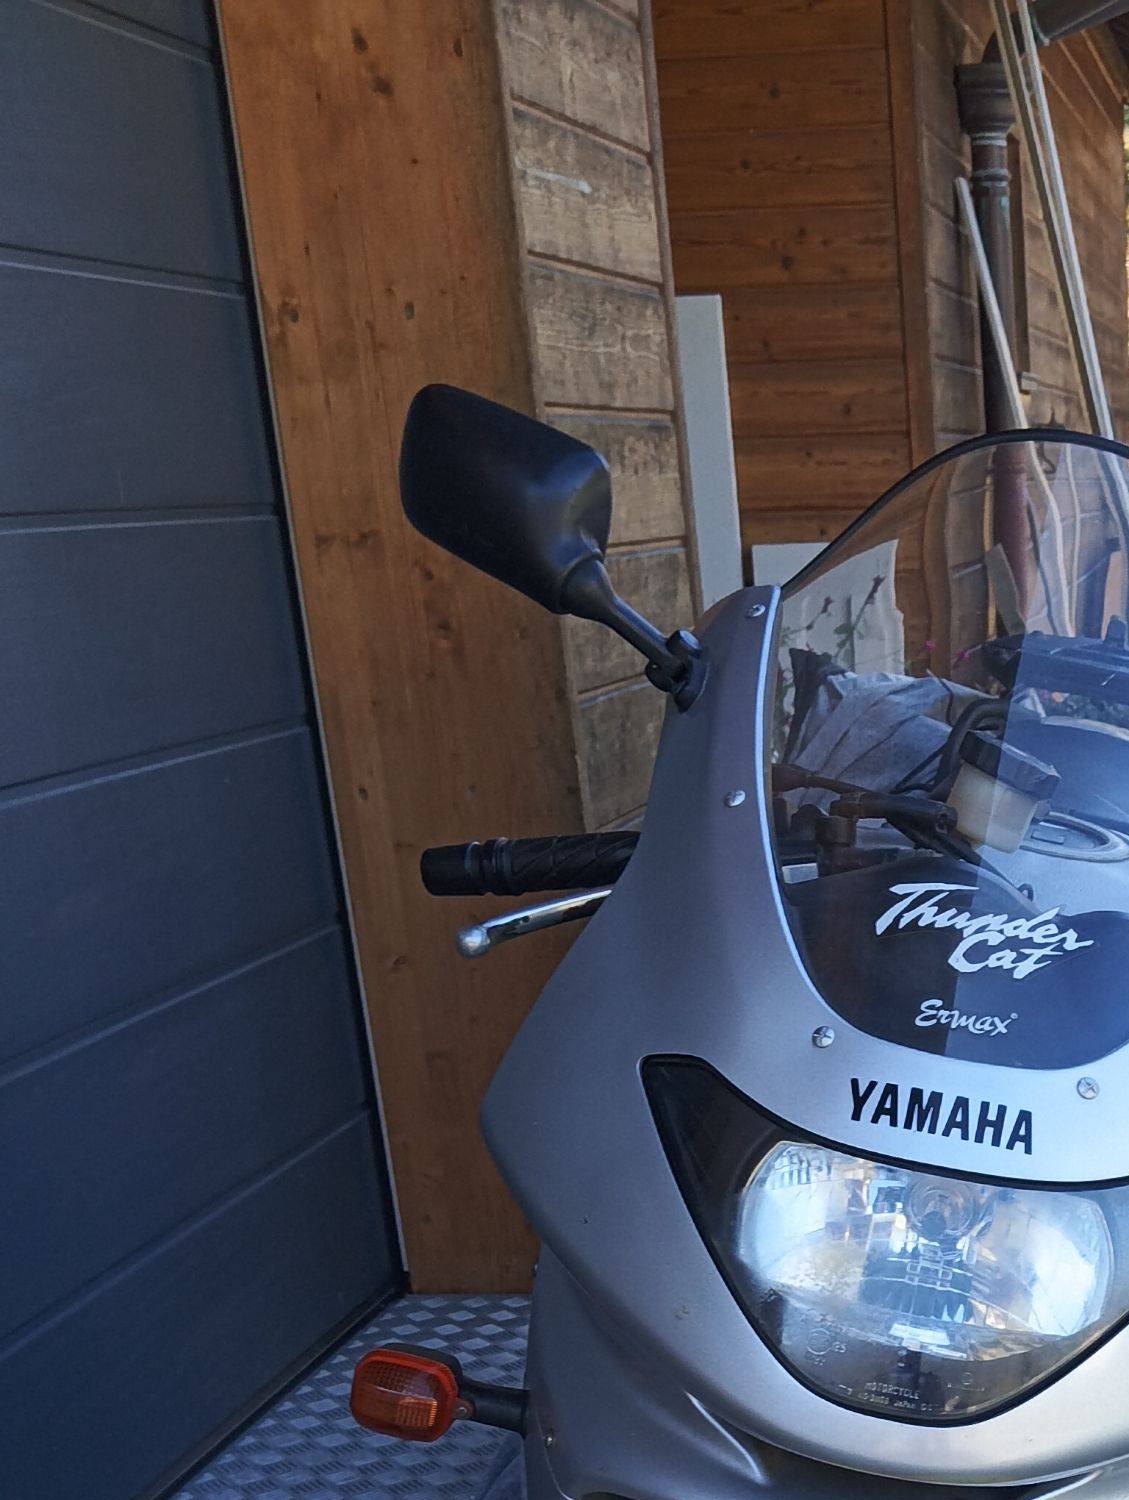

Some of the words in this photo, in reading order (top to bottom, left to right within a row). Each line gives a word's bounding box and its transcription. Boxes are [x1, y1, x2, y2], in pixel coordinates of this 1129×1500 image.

[874, 882, 1095, 950] Thunder
[947, 930, 1064, 980] Cat
[914, 998, 1018, 1037] Ermax
[849, 1077, 1033, 1155] YAMAHA
